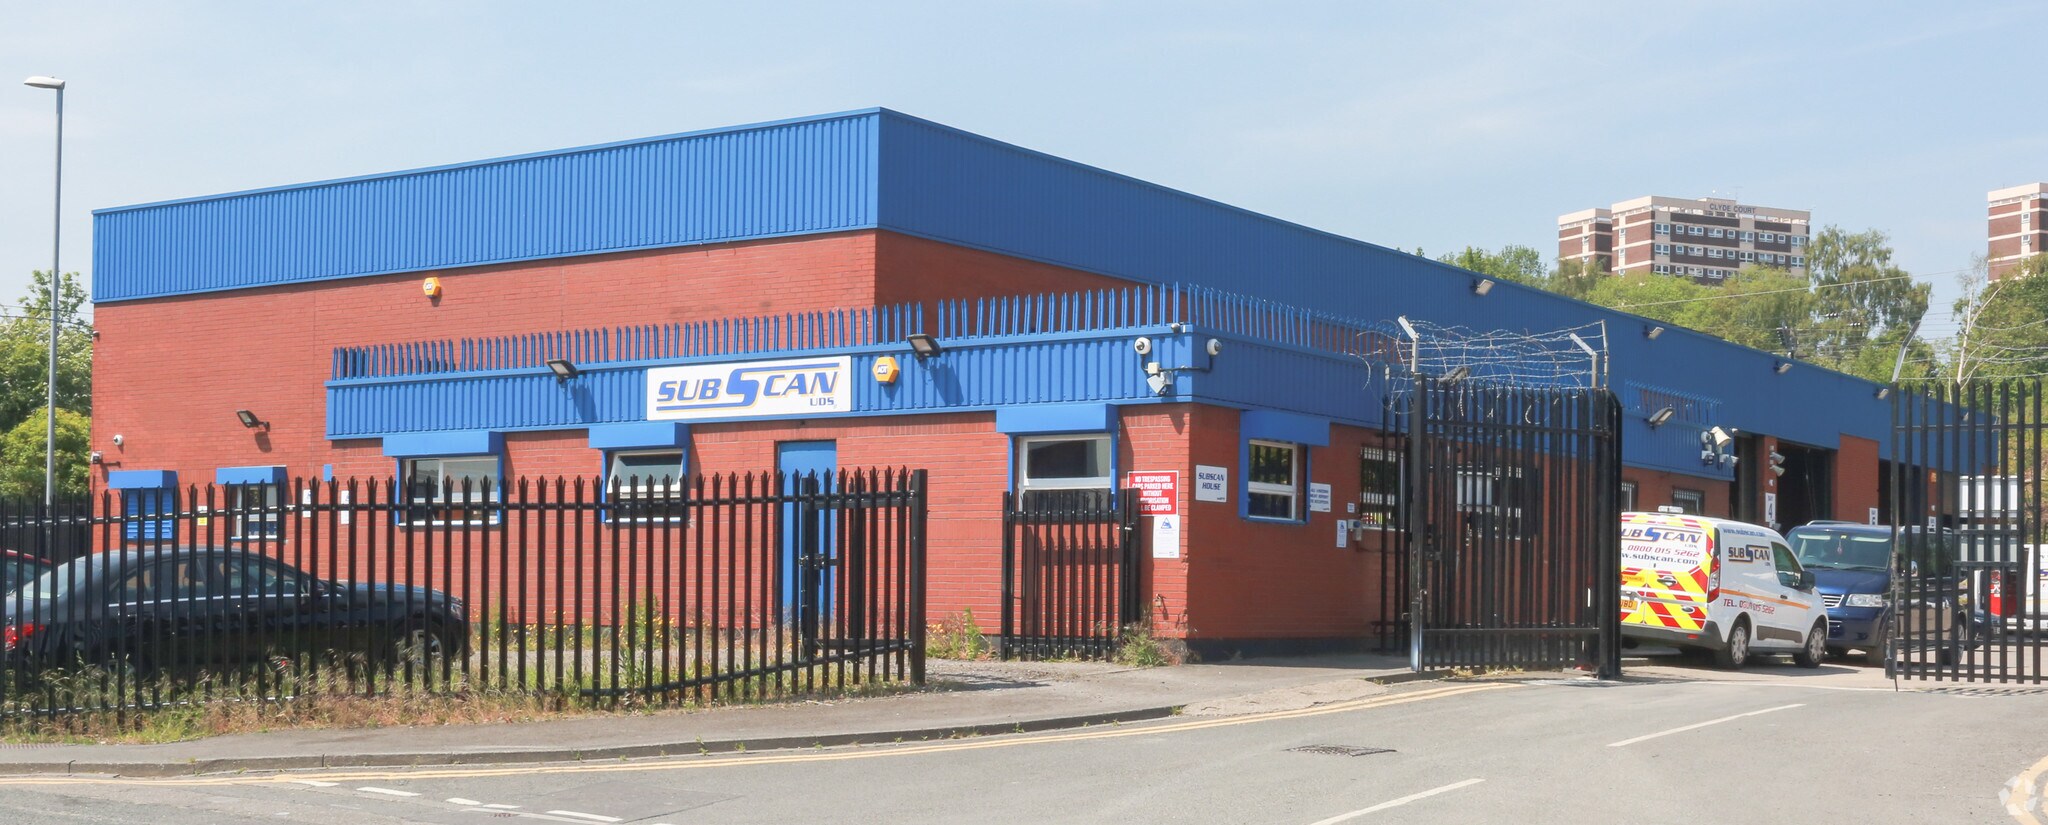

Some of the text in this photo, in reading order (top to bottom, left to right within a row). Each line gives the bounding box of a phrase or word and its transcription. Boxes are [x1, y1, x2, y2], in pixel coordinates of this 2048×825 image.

[1710, 203, 1731, 211] CLYDE
[656, 363, 840, 411] SUBSCAN
[810, 397, 834, 406] UDS
[1141, 475, 1171, 483] TRESPASSING
[1198, 472, 1224, 481] SUBSCAN
[1202, 482, 1221, 490] HOUSE
[1768, 503, 1773, 519] 4
[1621, 527, 1702, 543] UBSCAN
[1627, 544, 1652, 552] 0800
[1675, 549, 1700, 558] 5262
[1728, 544, 1770, 563] SUBSCAN
[1621, 552, 1698, 565] w.subscan.com
[1723, 598, 1737, 607] TEL.
